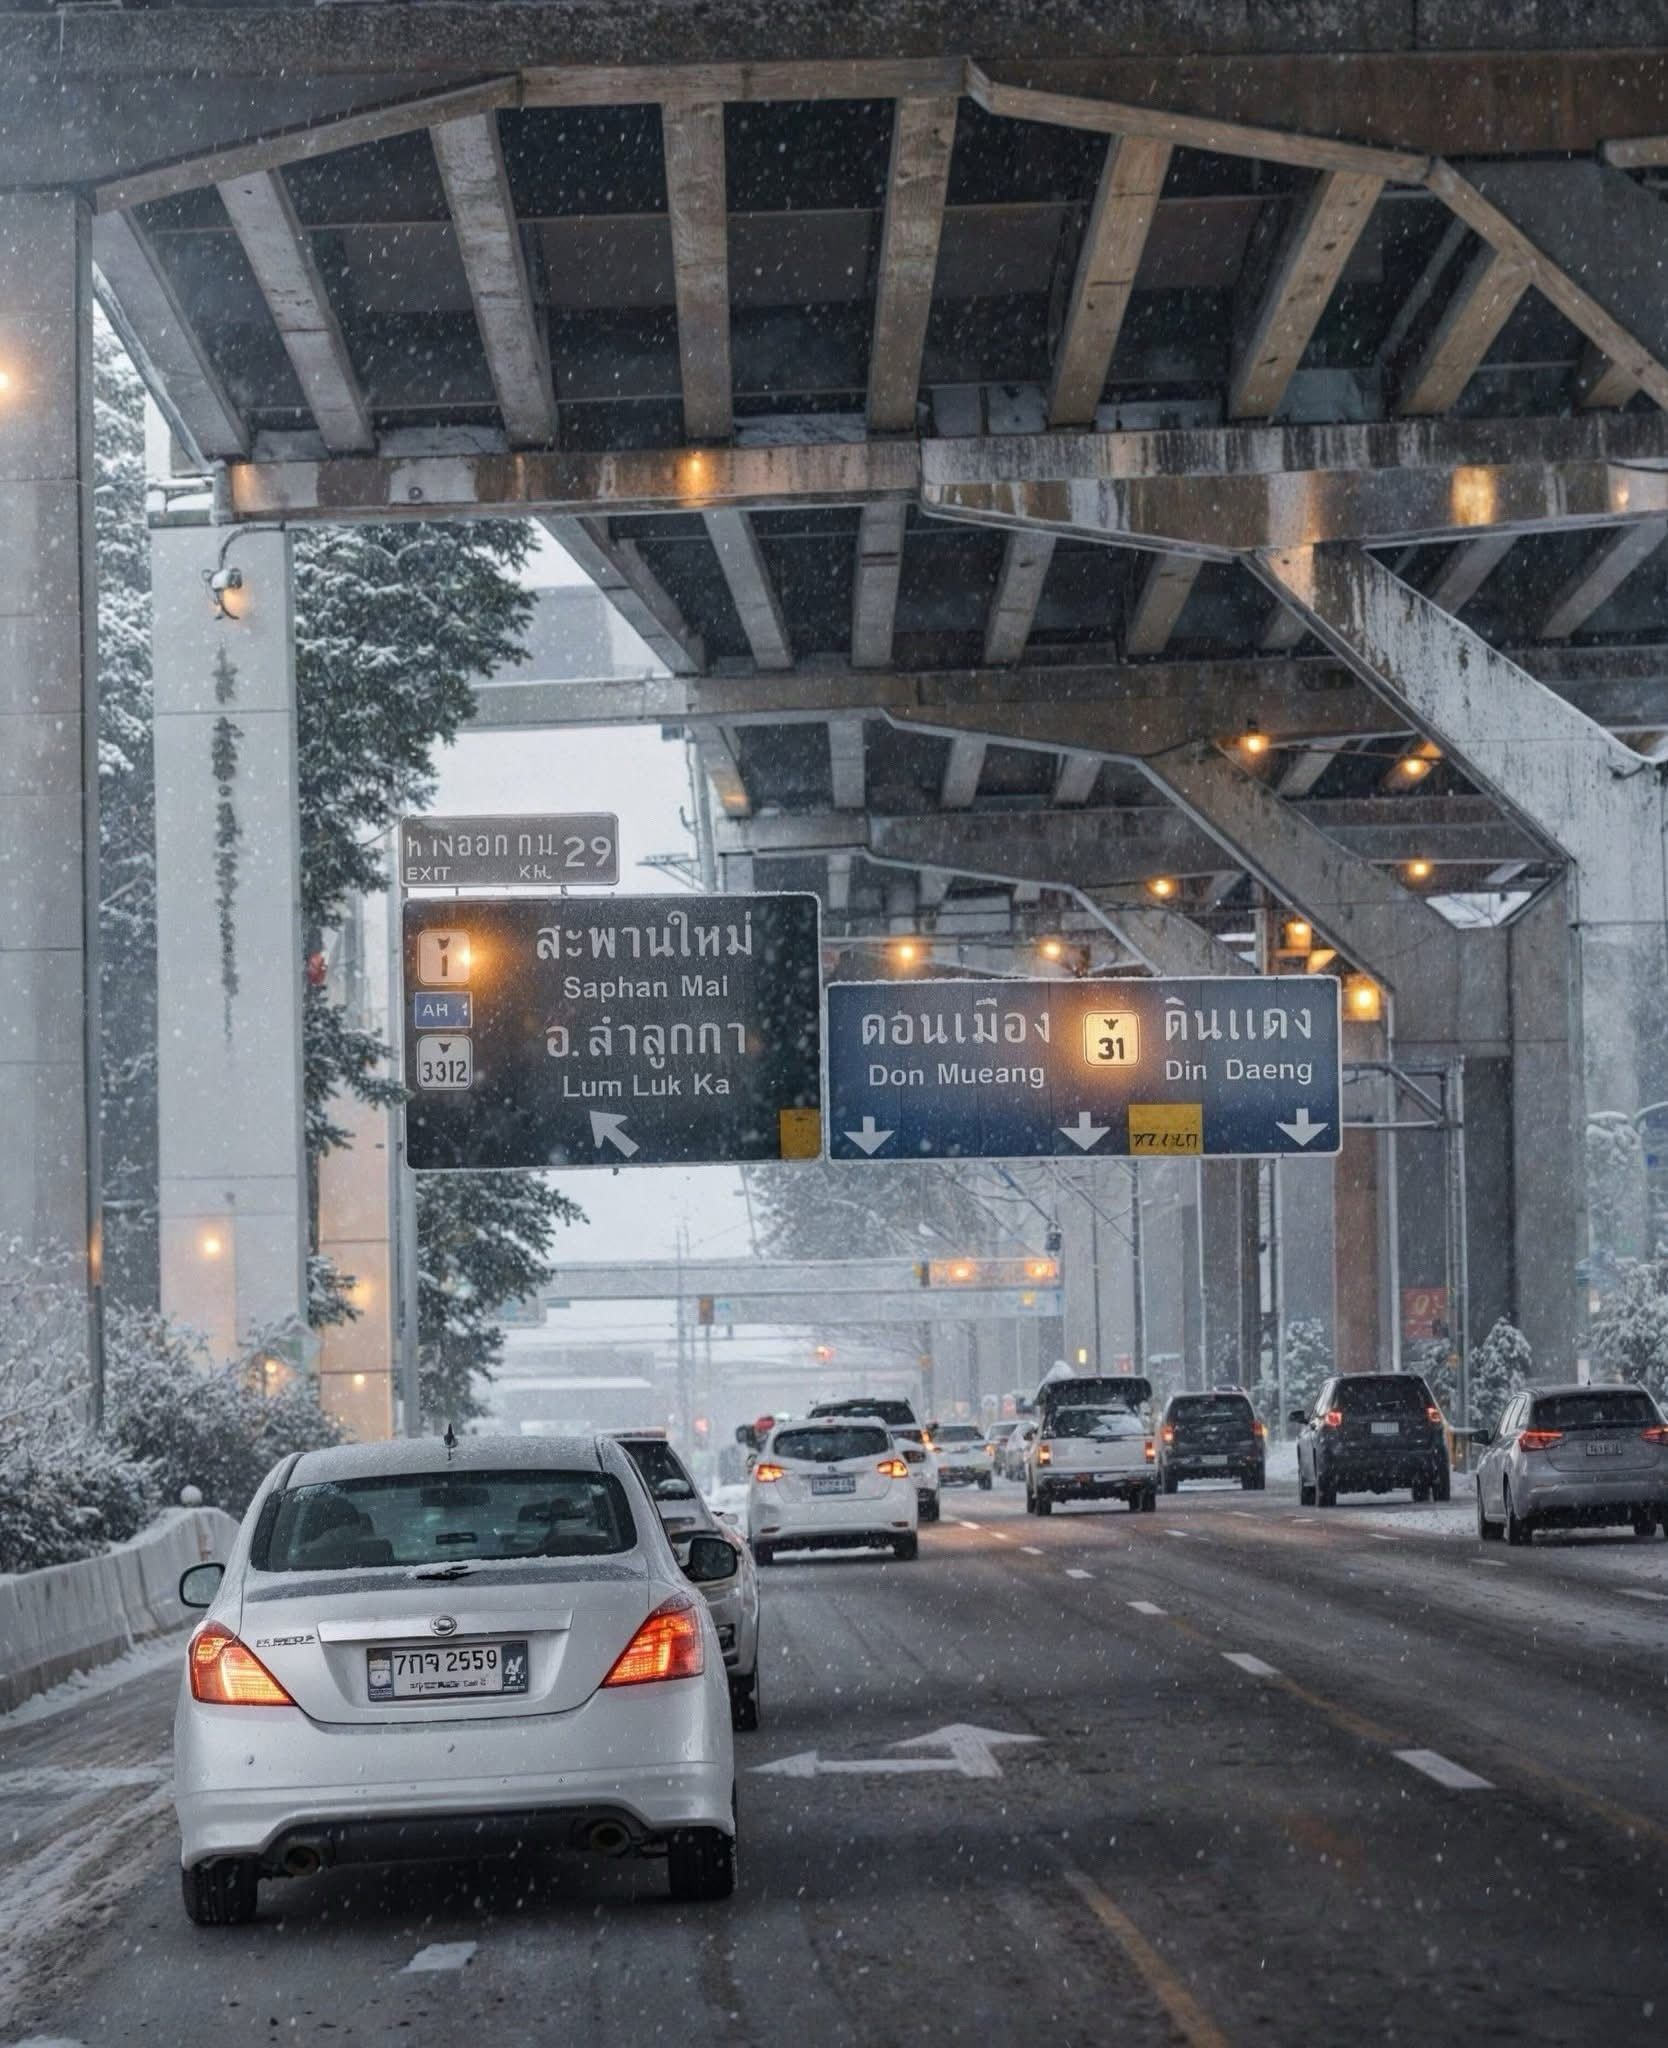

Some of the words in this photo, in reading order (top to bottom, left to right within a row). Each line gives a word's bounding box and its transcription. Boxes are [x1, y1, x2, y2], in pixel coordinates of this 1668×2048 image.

[563, 835, 612, 867] 29
[407, 865, 451, 881] EXIT
[441, 954, 449, 977] 1
[563, 975, 668, 1003] Saphan
[1164, 996, 1312, 1041] ดินแดง
[1097, 1036, 1125, 1060] 31
[422, 1060, 468, 1083] 3312
[868, 1063, 924, 1086] Don
[937, 1062, 1045, 1089] Mueang
[1165, 1059, 1208, 1081] Din
[1225, 1058, 1313, 1086] Daeng
[562, 1075, 622, 1097] Lum
[633, 1074, 682, 1097] Luk
[693, 1072, 731, 1095] Ka
[446, 1649, 498, 1673] 2559
